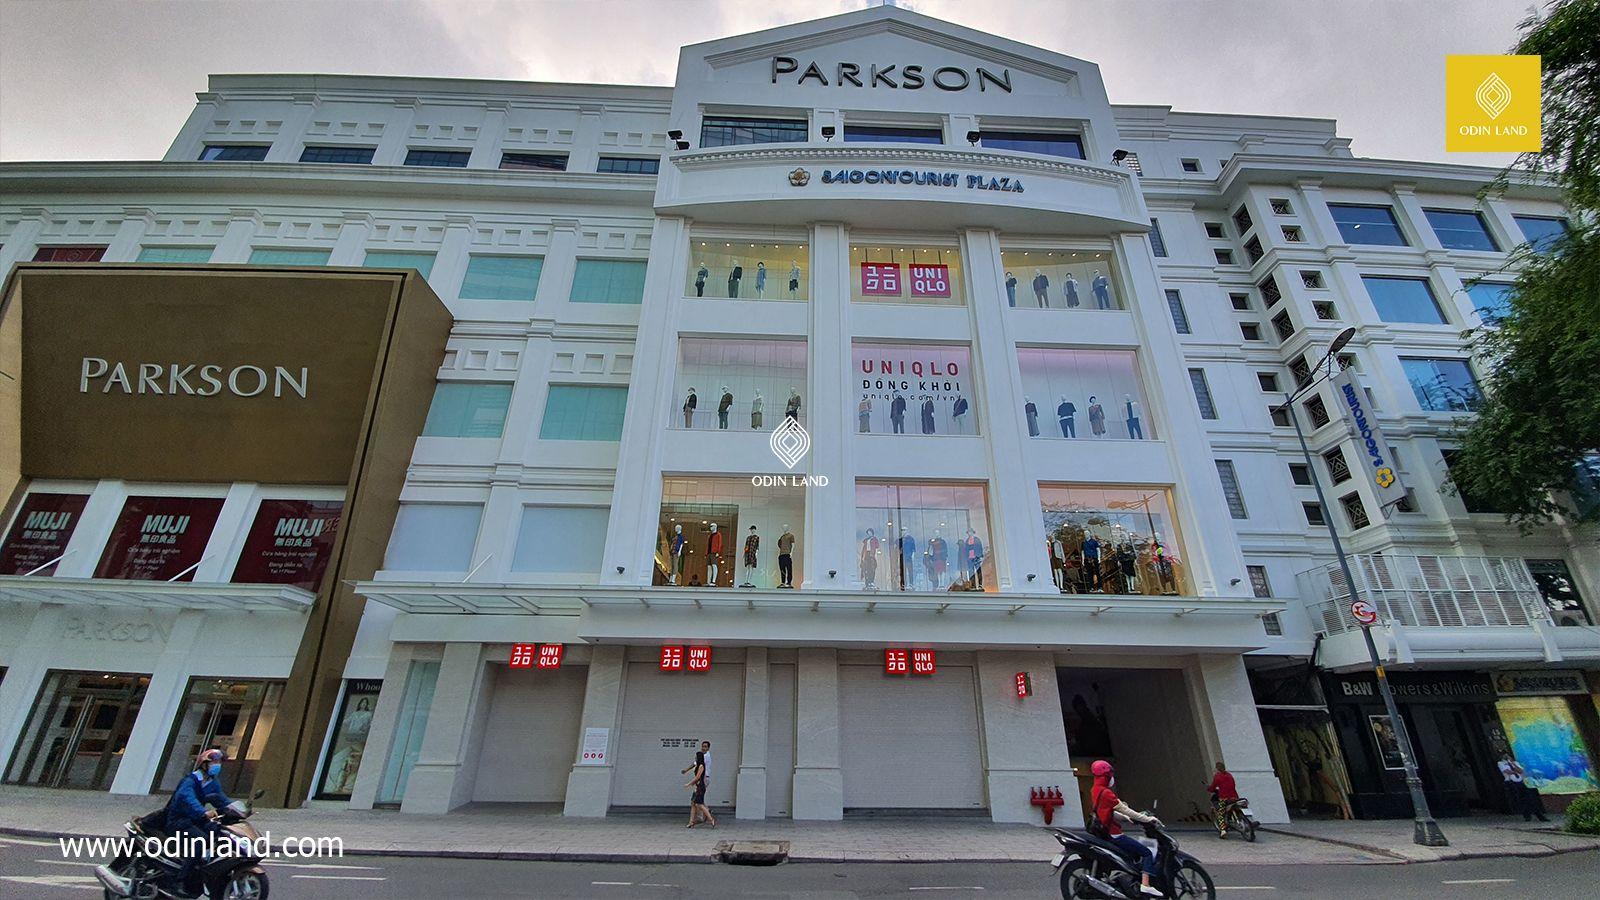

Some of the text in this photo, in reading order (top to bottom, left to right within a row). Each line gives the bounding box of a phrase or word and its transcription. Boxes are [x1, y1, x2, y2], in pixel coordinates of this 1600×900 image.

[771, 56, 1013, 94] PARKSON
[821, 169, 1025, 193] SAIGONTOURIST PLAZA
[866, 266, 896, 277] ユニ
[914, 267, 942, 279] UNI
[866, 279, 896, 291] クロ
[915, 280, 946, 293] QLO
[861, 360, 959, 378] UNIQLO
[79, 357, 308, 398] PARKSON
[23, 511, 72, 530] MUJI
[140, 514, 191, 534] MUJI
[274, 517, 325, 537] MUJI
[541, 647, 559, 656] UNI
[690, 650, 707, 658] UNI
[914, 653, 931, 661] UNI
[539, 657, 558, 667] QLO
[689, 659, 708, 668] QLO
[914, 662, 933, 672] QLO
[1341, 680, 1491, 696] B&W owers&Wilkins
